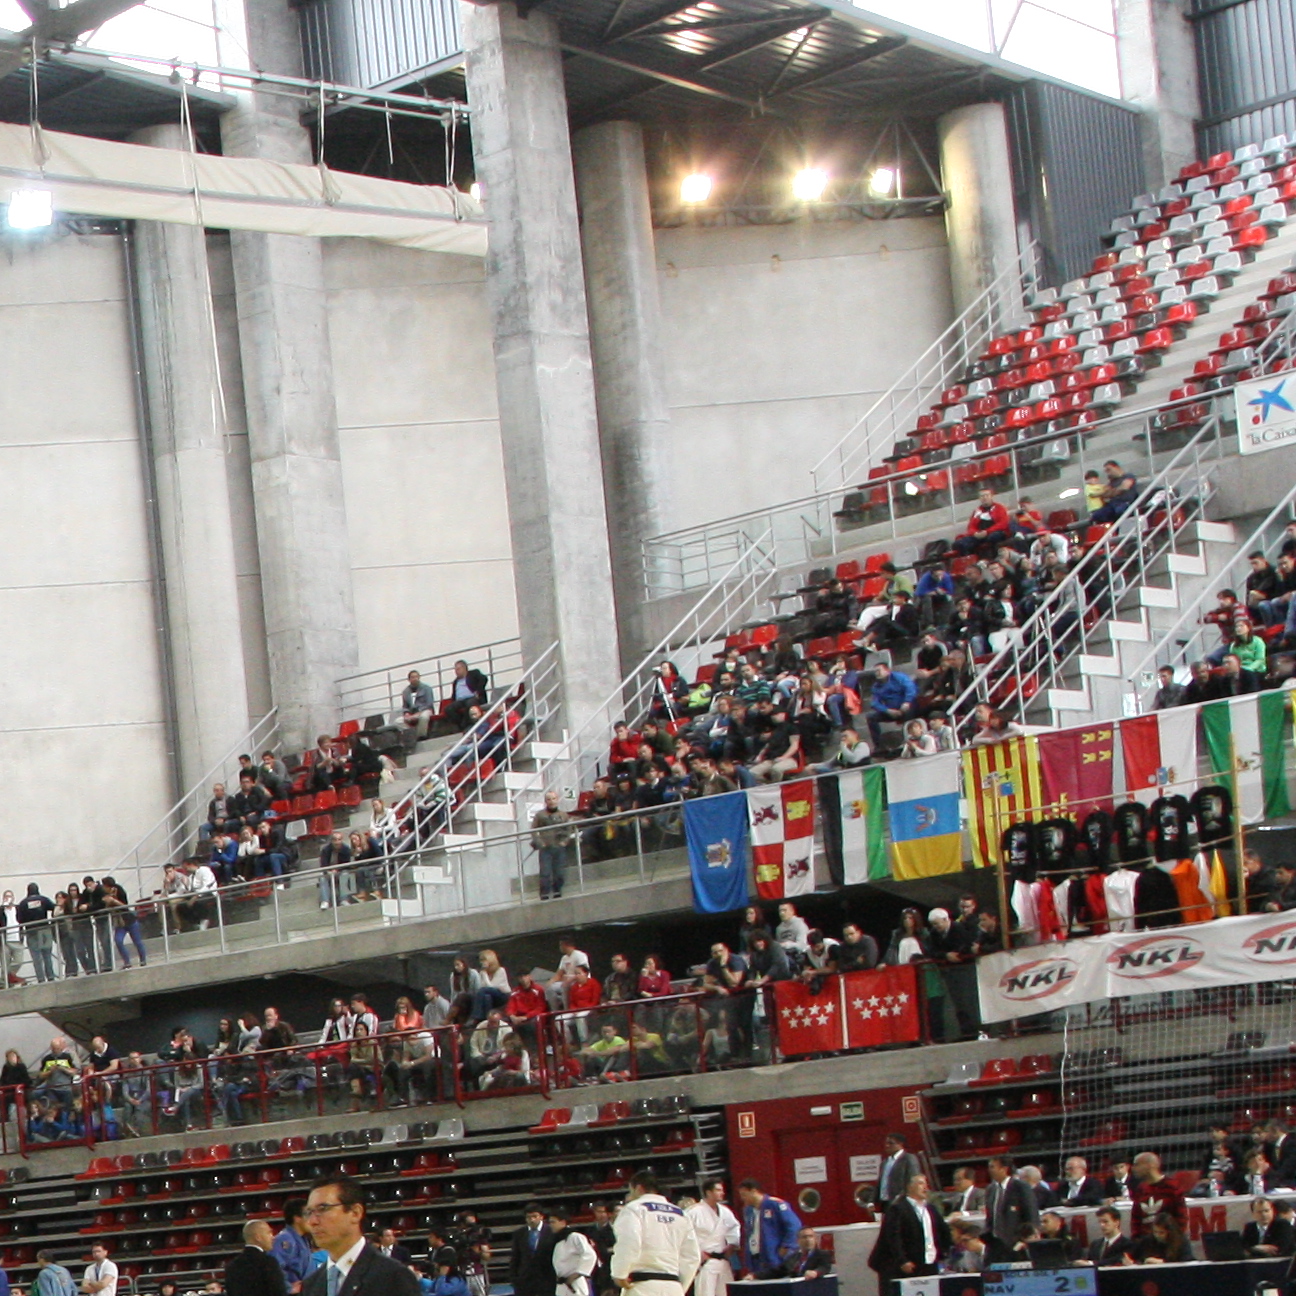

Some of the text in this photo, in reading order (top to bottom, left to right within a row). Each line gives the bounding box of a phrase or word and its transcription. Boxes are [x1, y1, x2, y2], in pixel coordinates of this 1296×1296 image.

[1117, 945, 1200, 970] NKL
[1007, 967, 1074, 993] NKL
[985, 1276, 1070, 1294] NAV 2
